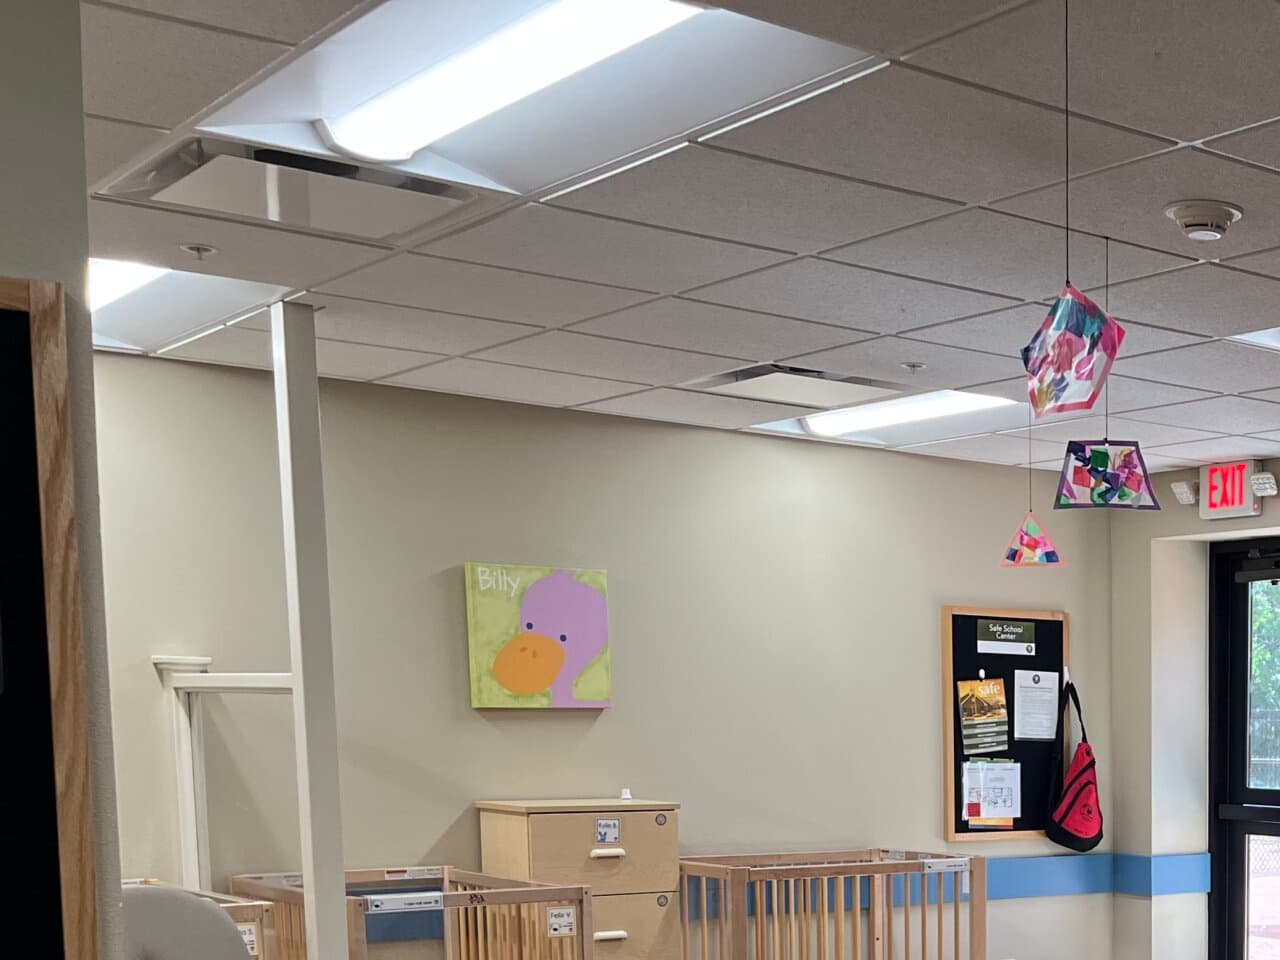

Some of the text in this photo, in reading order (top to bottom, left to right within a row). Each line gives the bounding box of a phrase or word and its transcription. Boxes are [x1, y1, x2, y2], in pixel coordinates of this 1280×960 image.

[1208, 464, 1247, 509] EXIT
[477, 567, 521, 597] Billy
[989, 624, 1024, 633] Safe School
[995, 632, 1017, 640] Center
[978, 683, 1001, 695] safe
